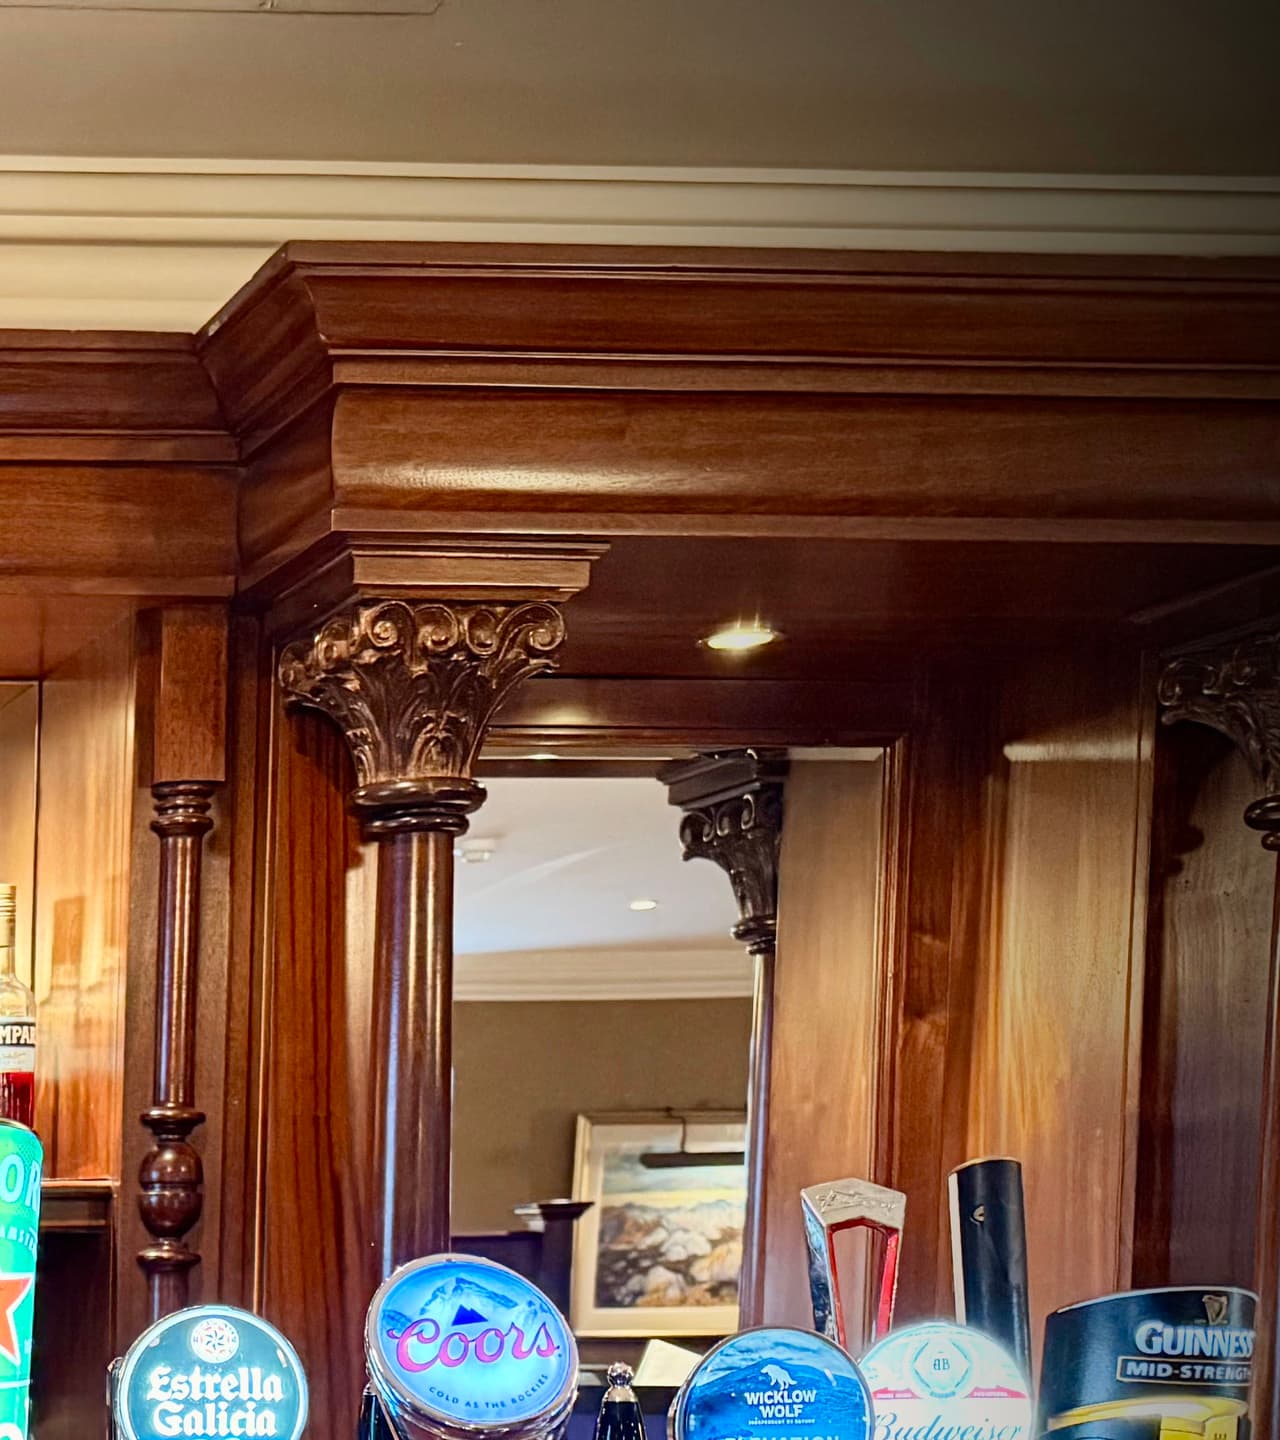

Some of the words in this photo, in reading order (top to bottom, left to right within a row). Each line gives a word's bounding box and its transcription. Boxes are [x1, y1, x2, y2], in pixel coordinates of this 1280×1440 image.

[386, 1318, 561, 1373] Coors
[1135, 1320, 1256, 1358] GUINNESS
[146, 1365, 285, 1402] Estrella
[428, 1386, 459, 1404] COLD
[484, 1400, 507, 1408] THE
[510, 1373, 549, 1404] ROCKIES
[744, 1389, 817, 1405] WICKLOW
[153, 1400, 278, 1437] Galicia
[759, 1404, 804, 1418] WOLF
